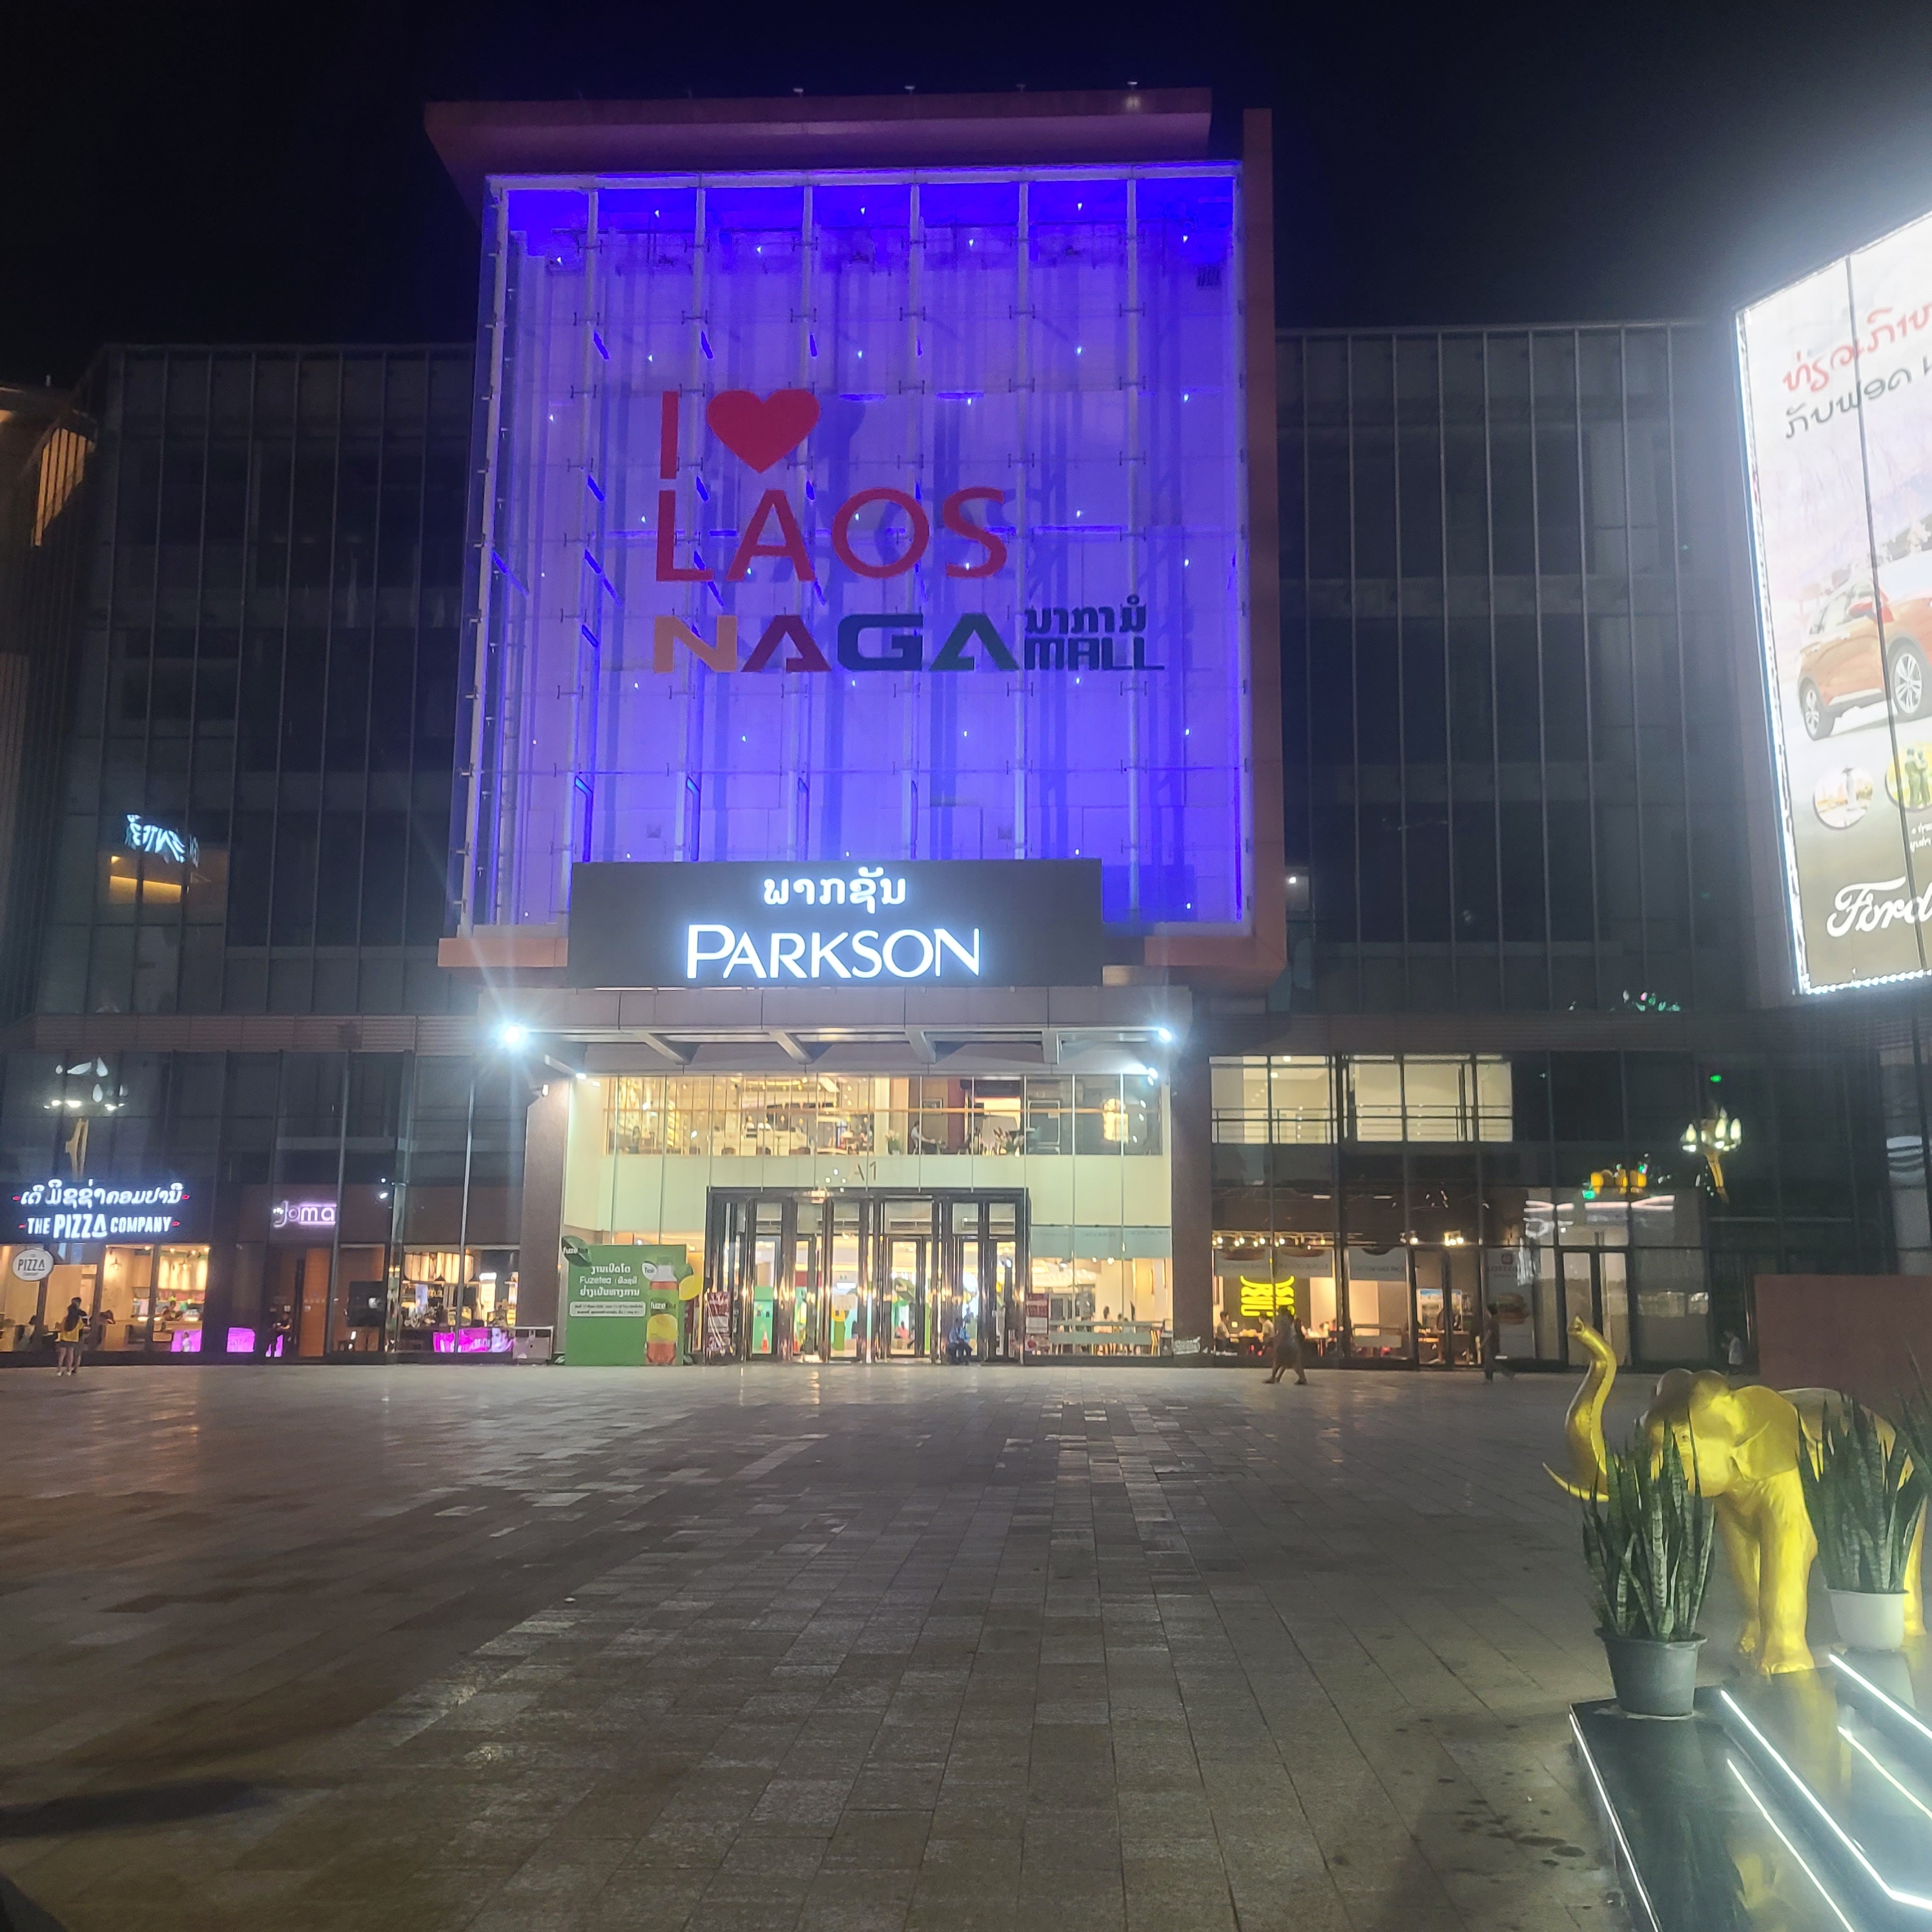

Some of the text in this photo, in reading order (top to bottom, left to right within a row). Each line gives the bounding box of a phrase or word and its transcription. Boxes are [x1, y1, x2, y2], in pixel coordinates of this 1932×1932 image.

[659, 391, 679, 479] I
[655, 486, 1007, 582] LAOS
[653, 613, 1019, 673] NAGA
[1024, 637, 1165, 671] MALL
[763, 866, 907, 914] ພາກຊັນ
[1826, 876, 1932, 938] Ford
[686, 924, 980, 979] PARKSON
[847, 1160, 877, 1182] A1
[27, 1213, 172, 1238] THE PIZZA COMPANY
[17, 1259, 46, 1271] PIZZA
